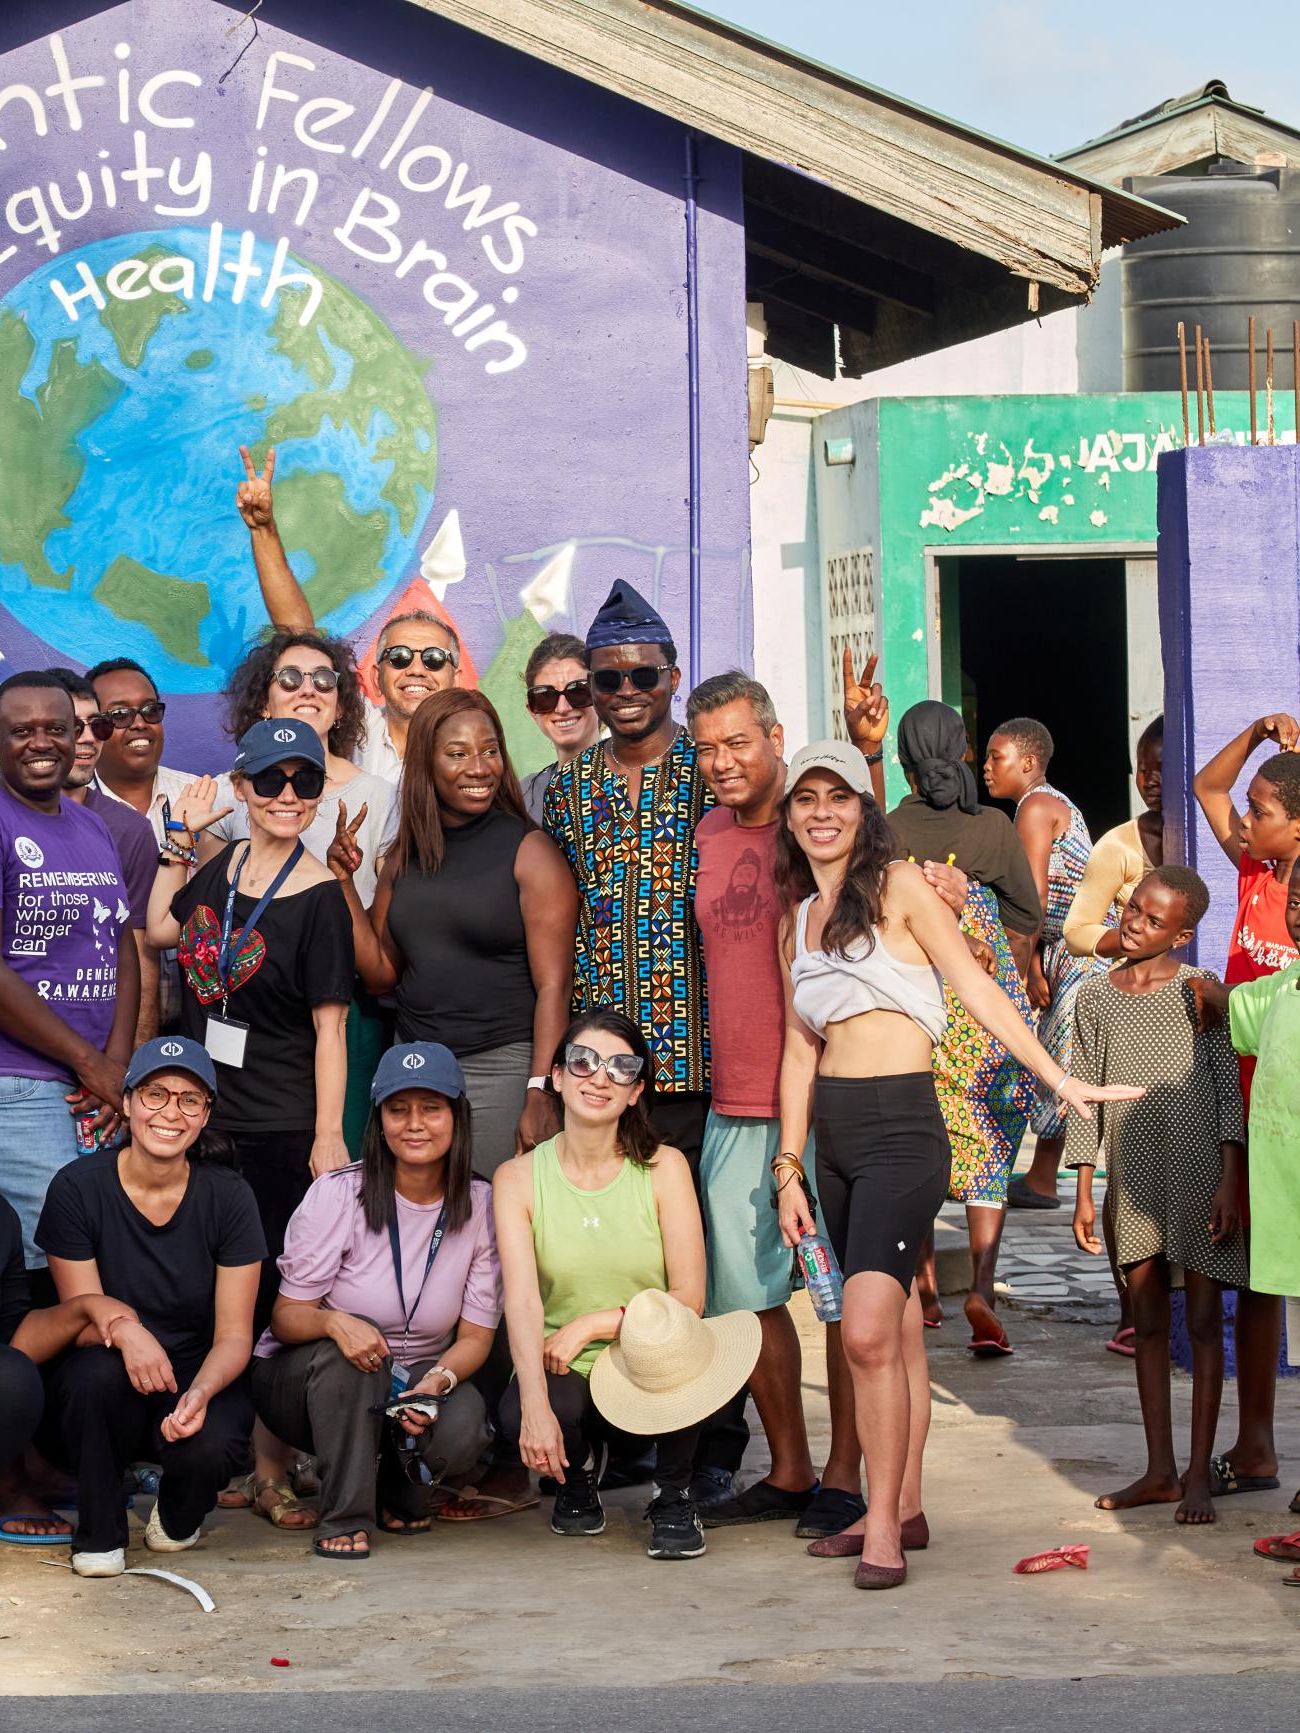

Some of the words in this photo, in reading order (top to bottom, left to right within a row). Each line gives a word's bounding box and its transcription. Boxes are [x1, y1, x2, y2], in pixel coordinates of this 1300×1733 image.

[254, 51, 538, 274] Fellows
[248, 146, 319, 226] in
[333, 188, 529, 374] Brain
[49, 222, 323, 326] Health
[19, 871, 118, 888] REMEMBERING
[17, 892, 45, 907] for
[50, 890, 90, 906] those
[16, 907, 58, 921] who
[62, 908, 80, 921] no
[15, 920, 72, 940] longer
[733, 921, 764, 942] WILD
[11, 938, 46, 952] can
